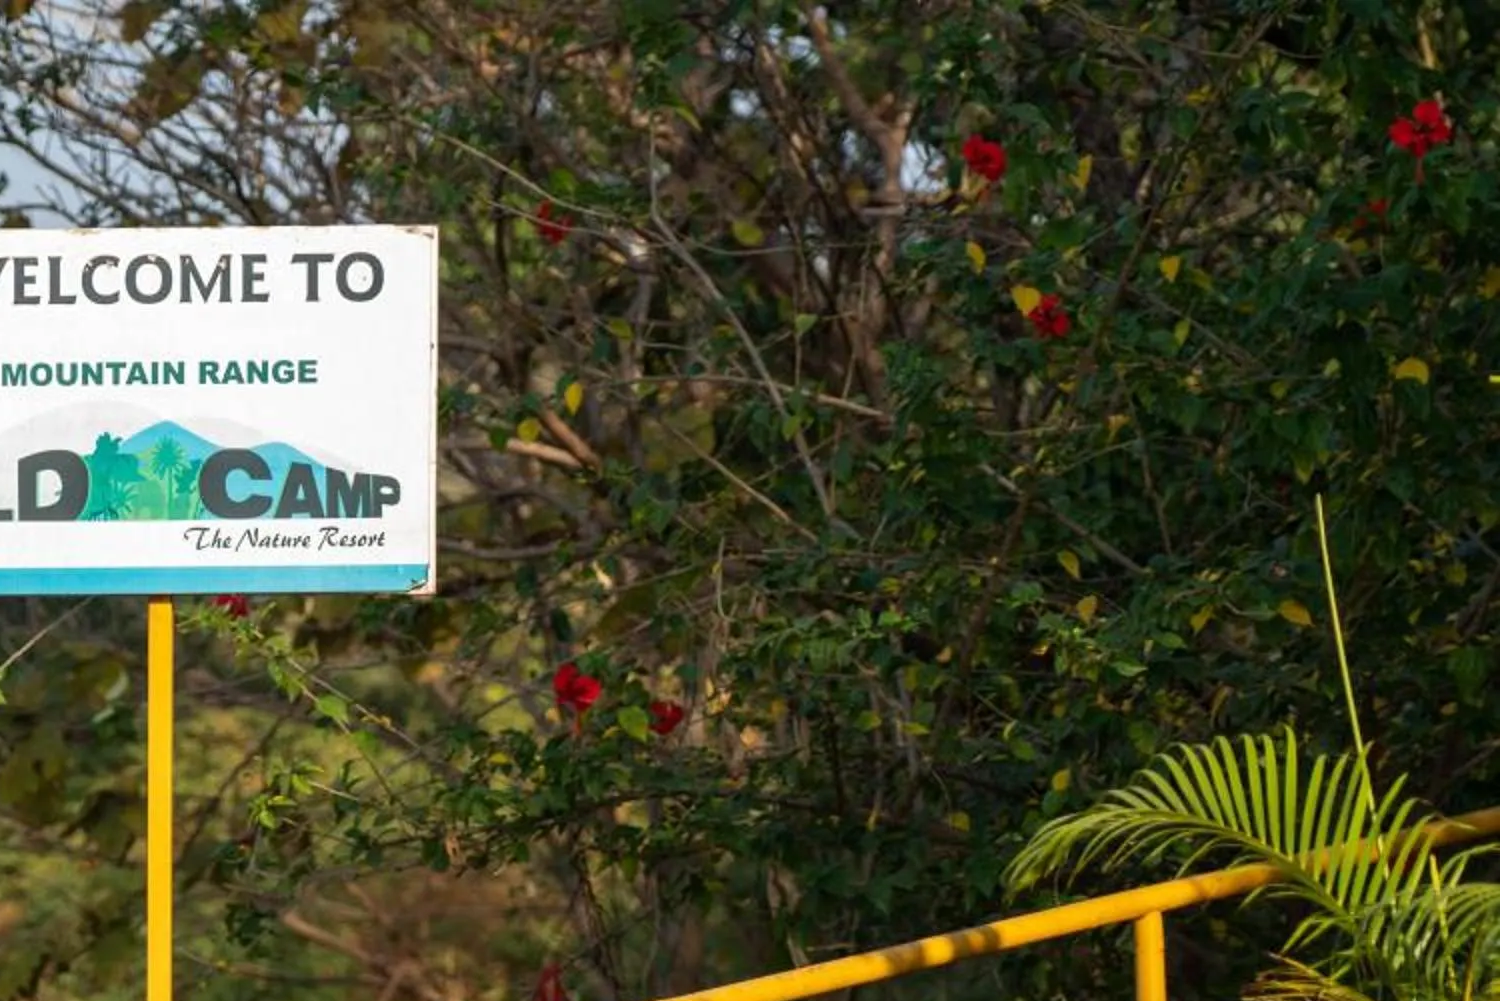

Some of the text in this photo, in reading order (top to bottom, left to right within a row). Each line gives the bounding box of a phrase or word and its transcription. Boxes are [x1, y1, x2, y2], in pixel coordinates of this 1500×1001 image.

[292, 252, 385, 303] TO
[1, 359, 318, 387] MOUNTAIN RANGE
[200, 448, 401, 520] CAMP
[184, 526, 386, 552] The Nature Resort
